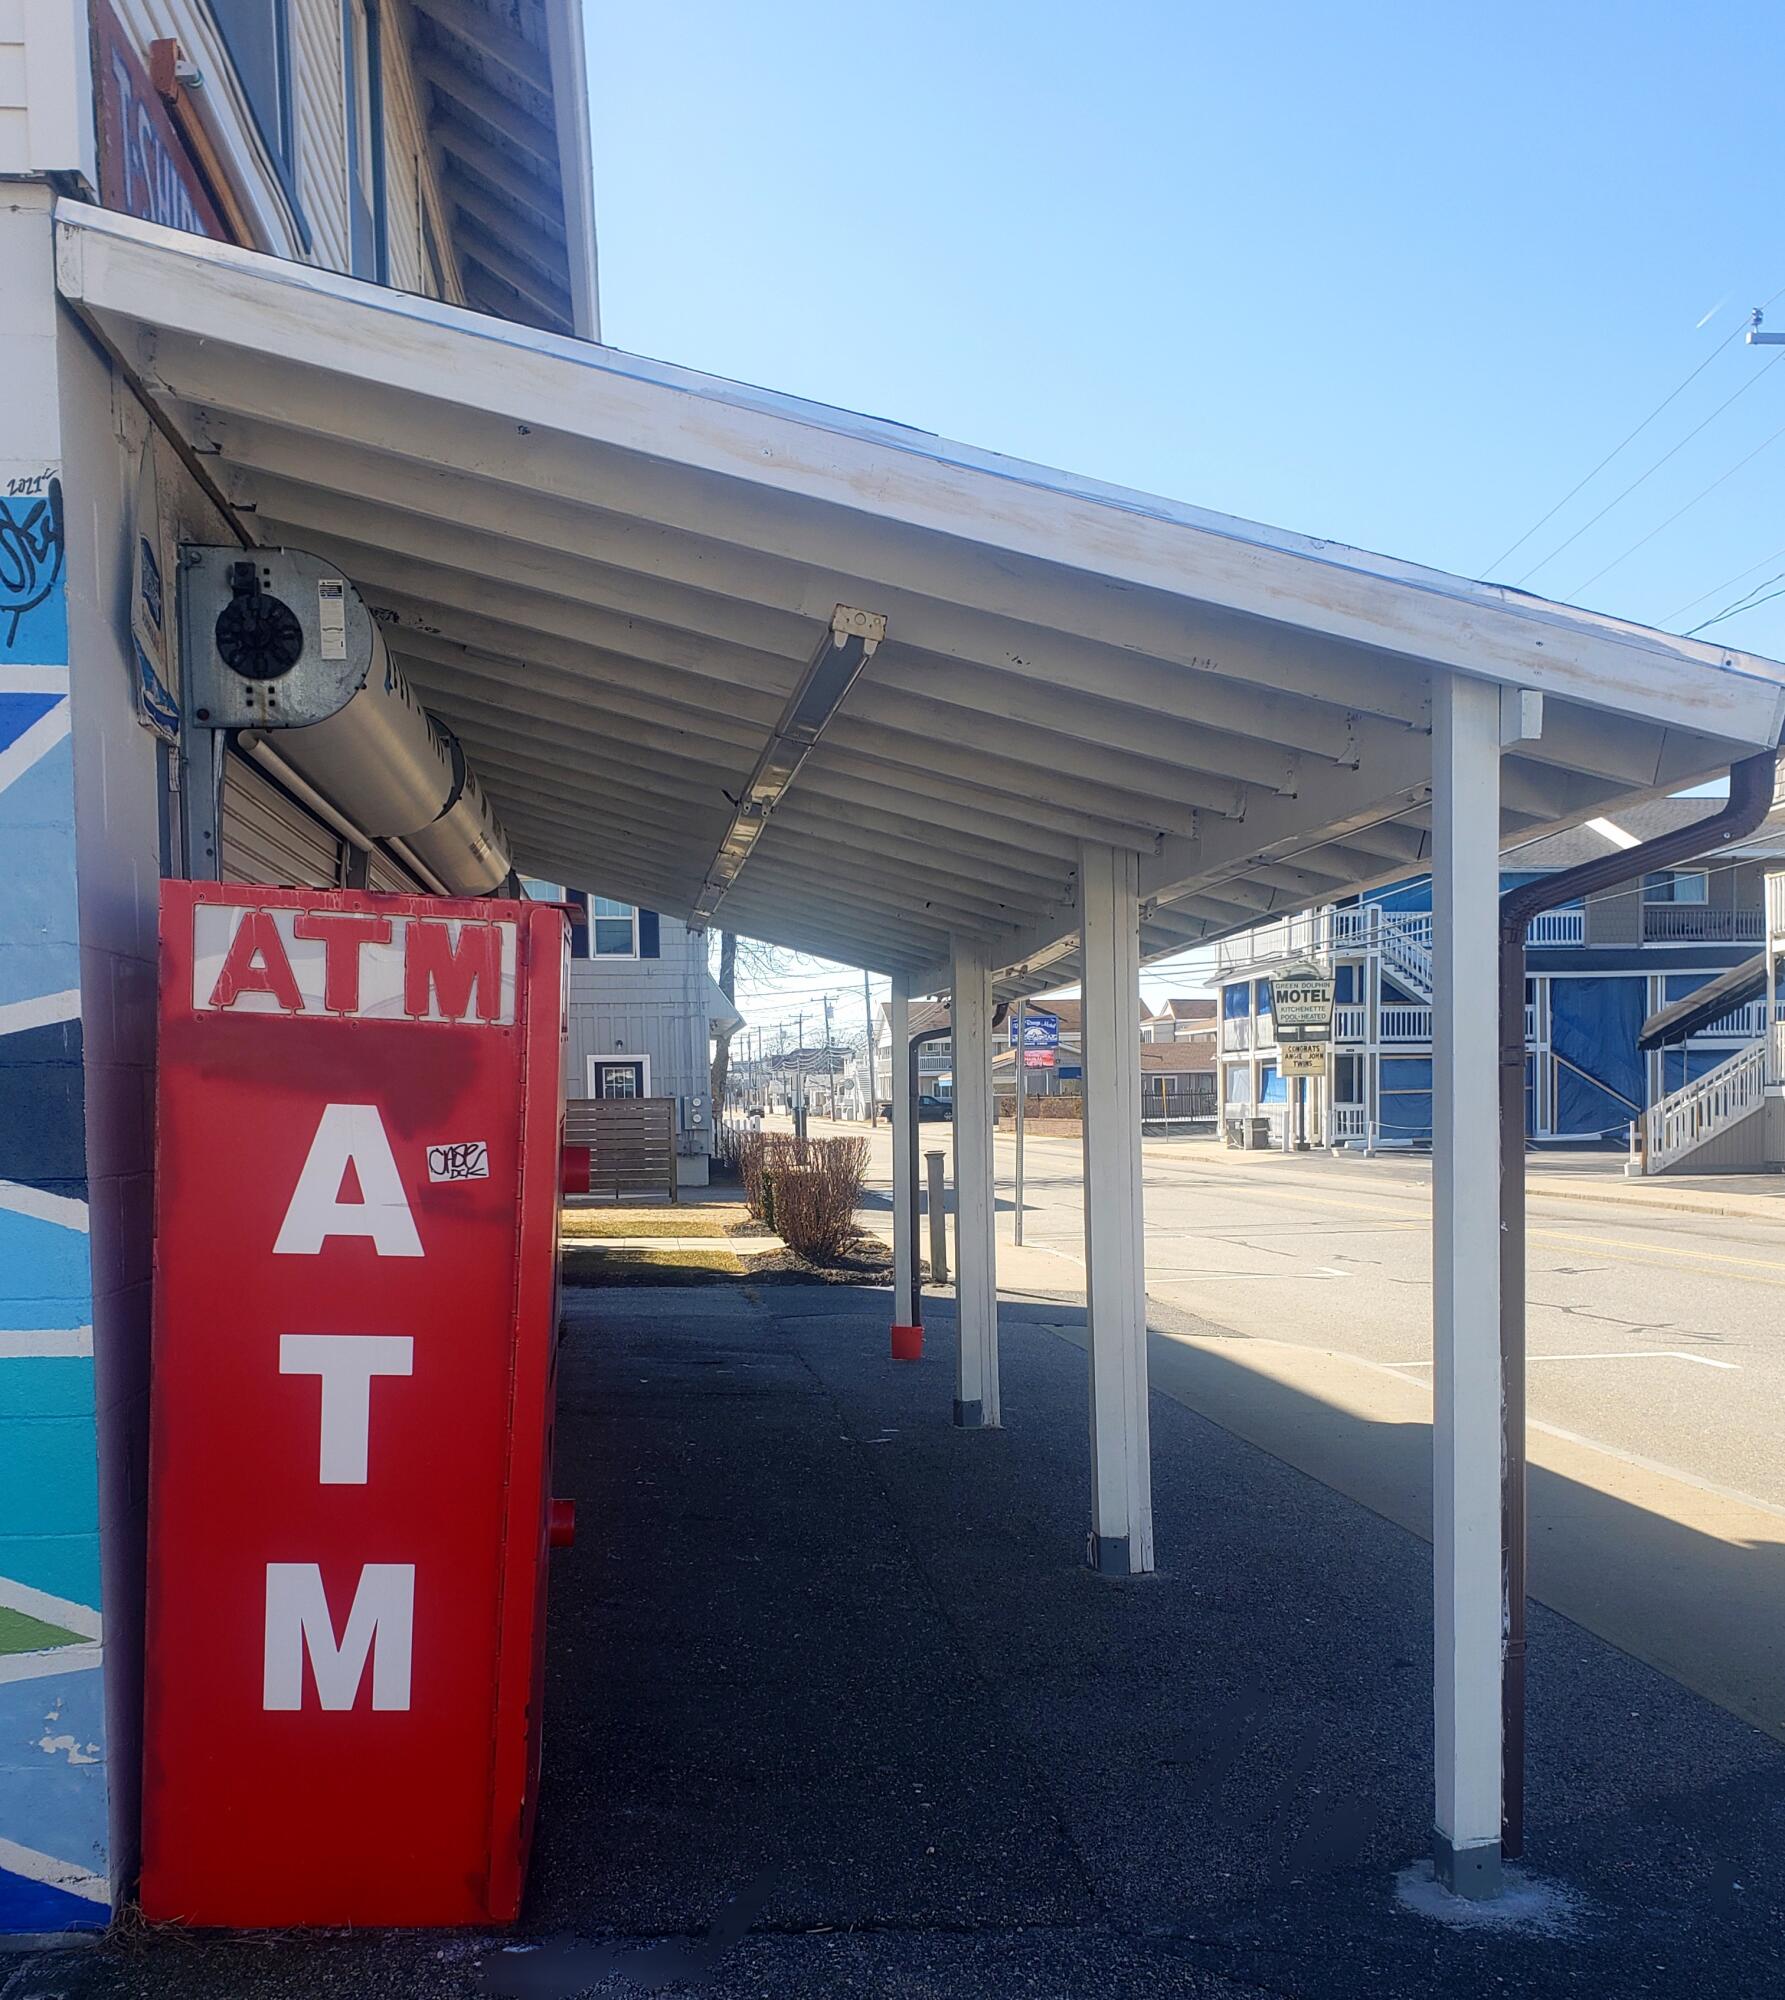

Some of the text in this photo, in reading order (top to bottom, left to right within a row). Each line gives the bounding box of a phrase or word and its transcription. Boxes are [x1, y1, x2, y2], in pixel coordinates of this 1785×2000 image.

[209, 912, 504, 1019] ATM
[1276, 989, 1331, 1003] MOTEL
[1280, 1005, 1326, 1013] KITCHENETTE
[1293, 1060, 1313, 1068] TWINS
